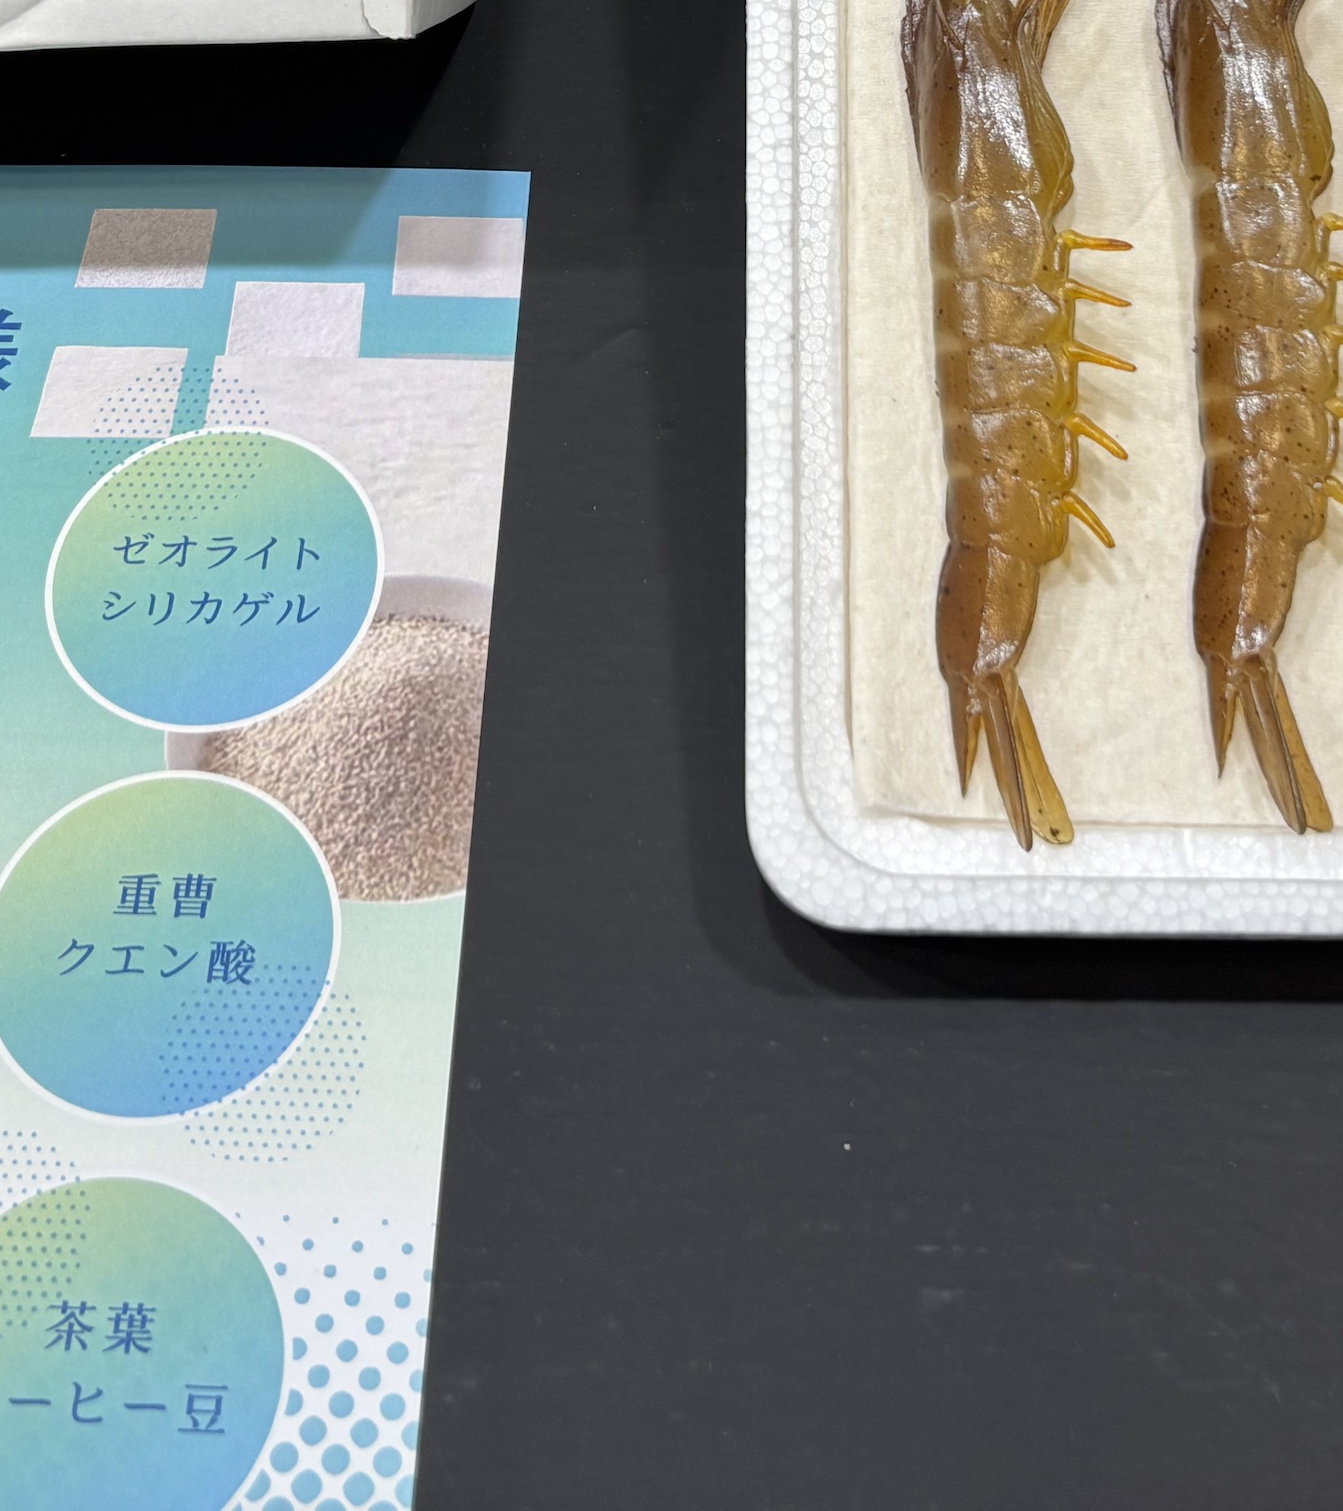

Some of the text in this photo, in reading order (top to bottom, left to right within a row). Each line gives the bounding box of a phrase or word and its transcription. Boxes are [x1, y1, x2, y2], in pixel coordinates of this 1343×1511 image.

[112, 533, 322, 572] ゼオライト
[101, 589, 322, 627] シリカゲル
[112, 872, 218, 921] 重曹
[56, 936, 258, 987] クエン酸
[44, 1299, 158, 1357] 茶葉
